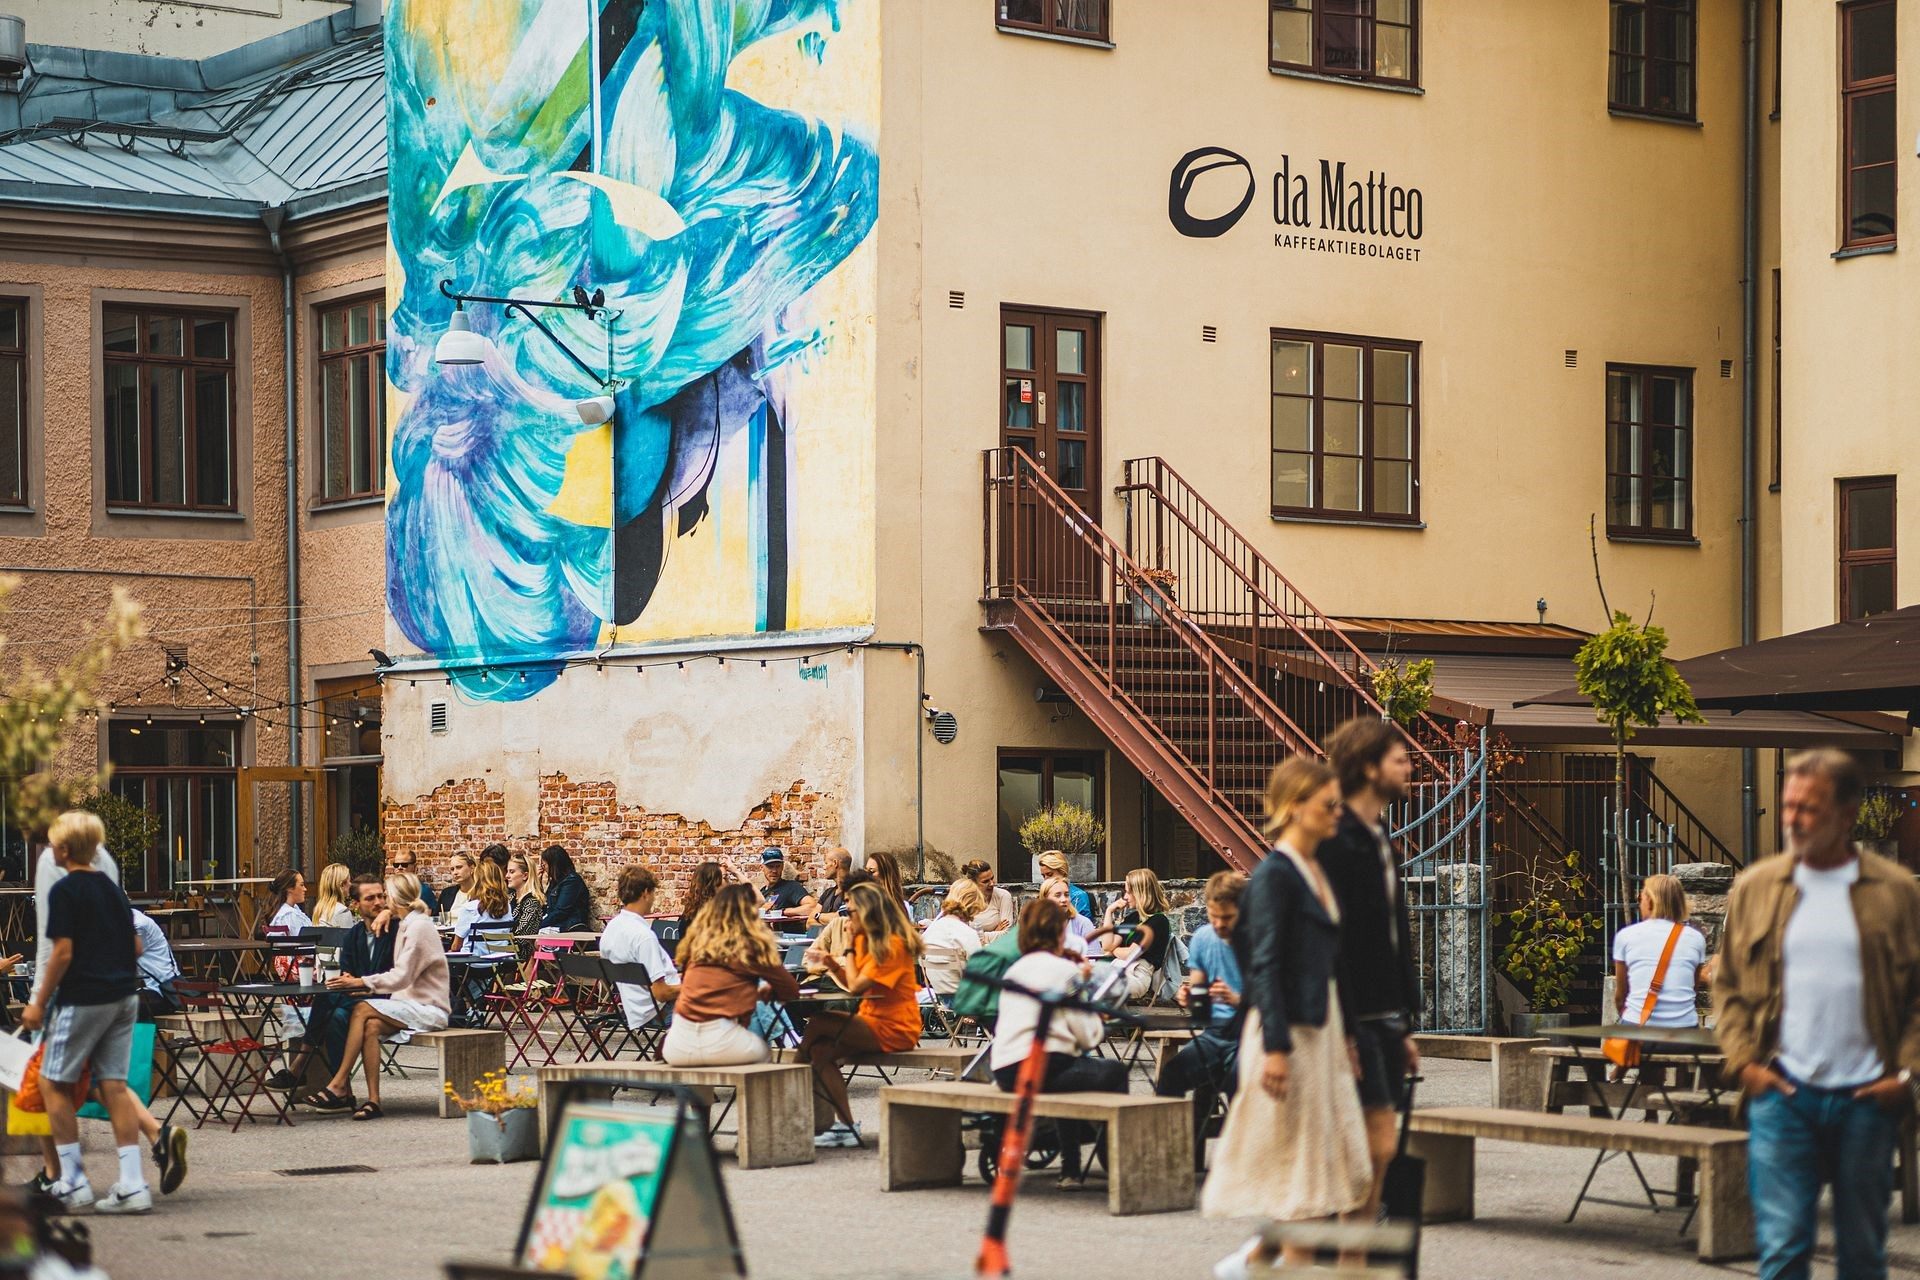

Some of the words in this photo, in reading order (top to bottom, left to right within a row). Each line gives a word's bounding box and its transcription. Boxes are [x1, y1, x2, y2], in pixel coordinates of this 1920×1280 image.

[1273, 154, 1312, 228] da
[1318, 158, 1423, 240] Matteo
[1274, 233, 1421, 262] KAFFEAKTIEBOLAGET
